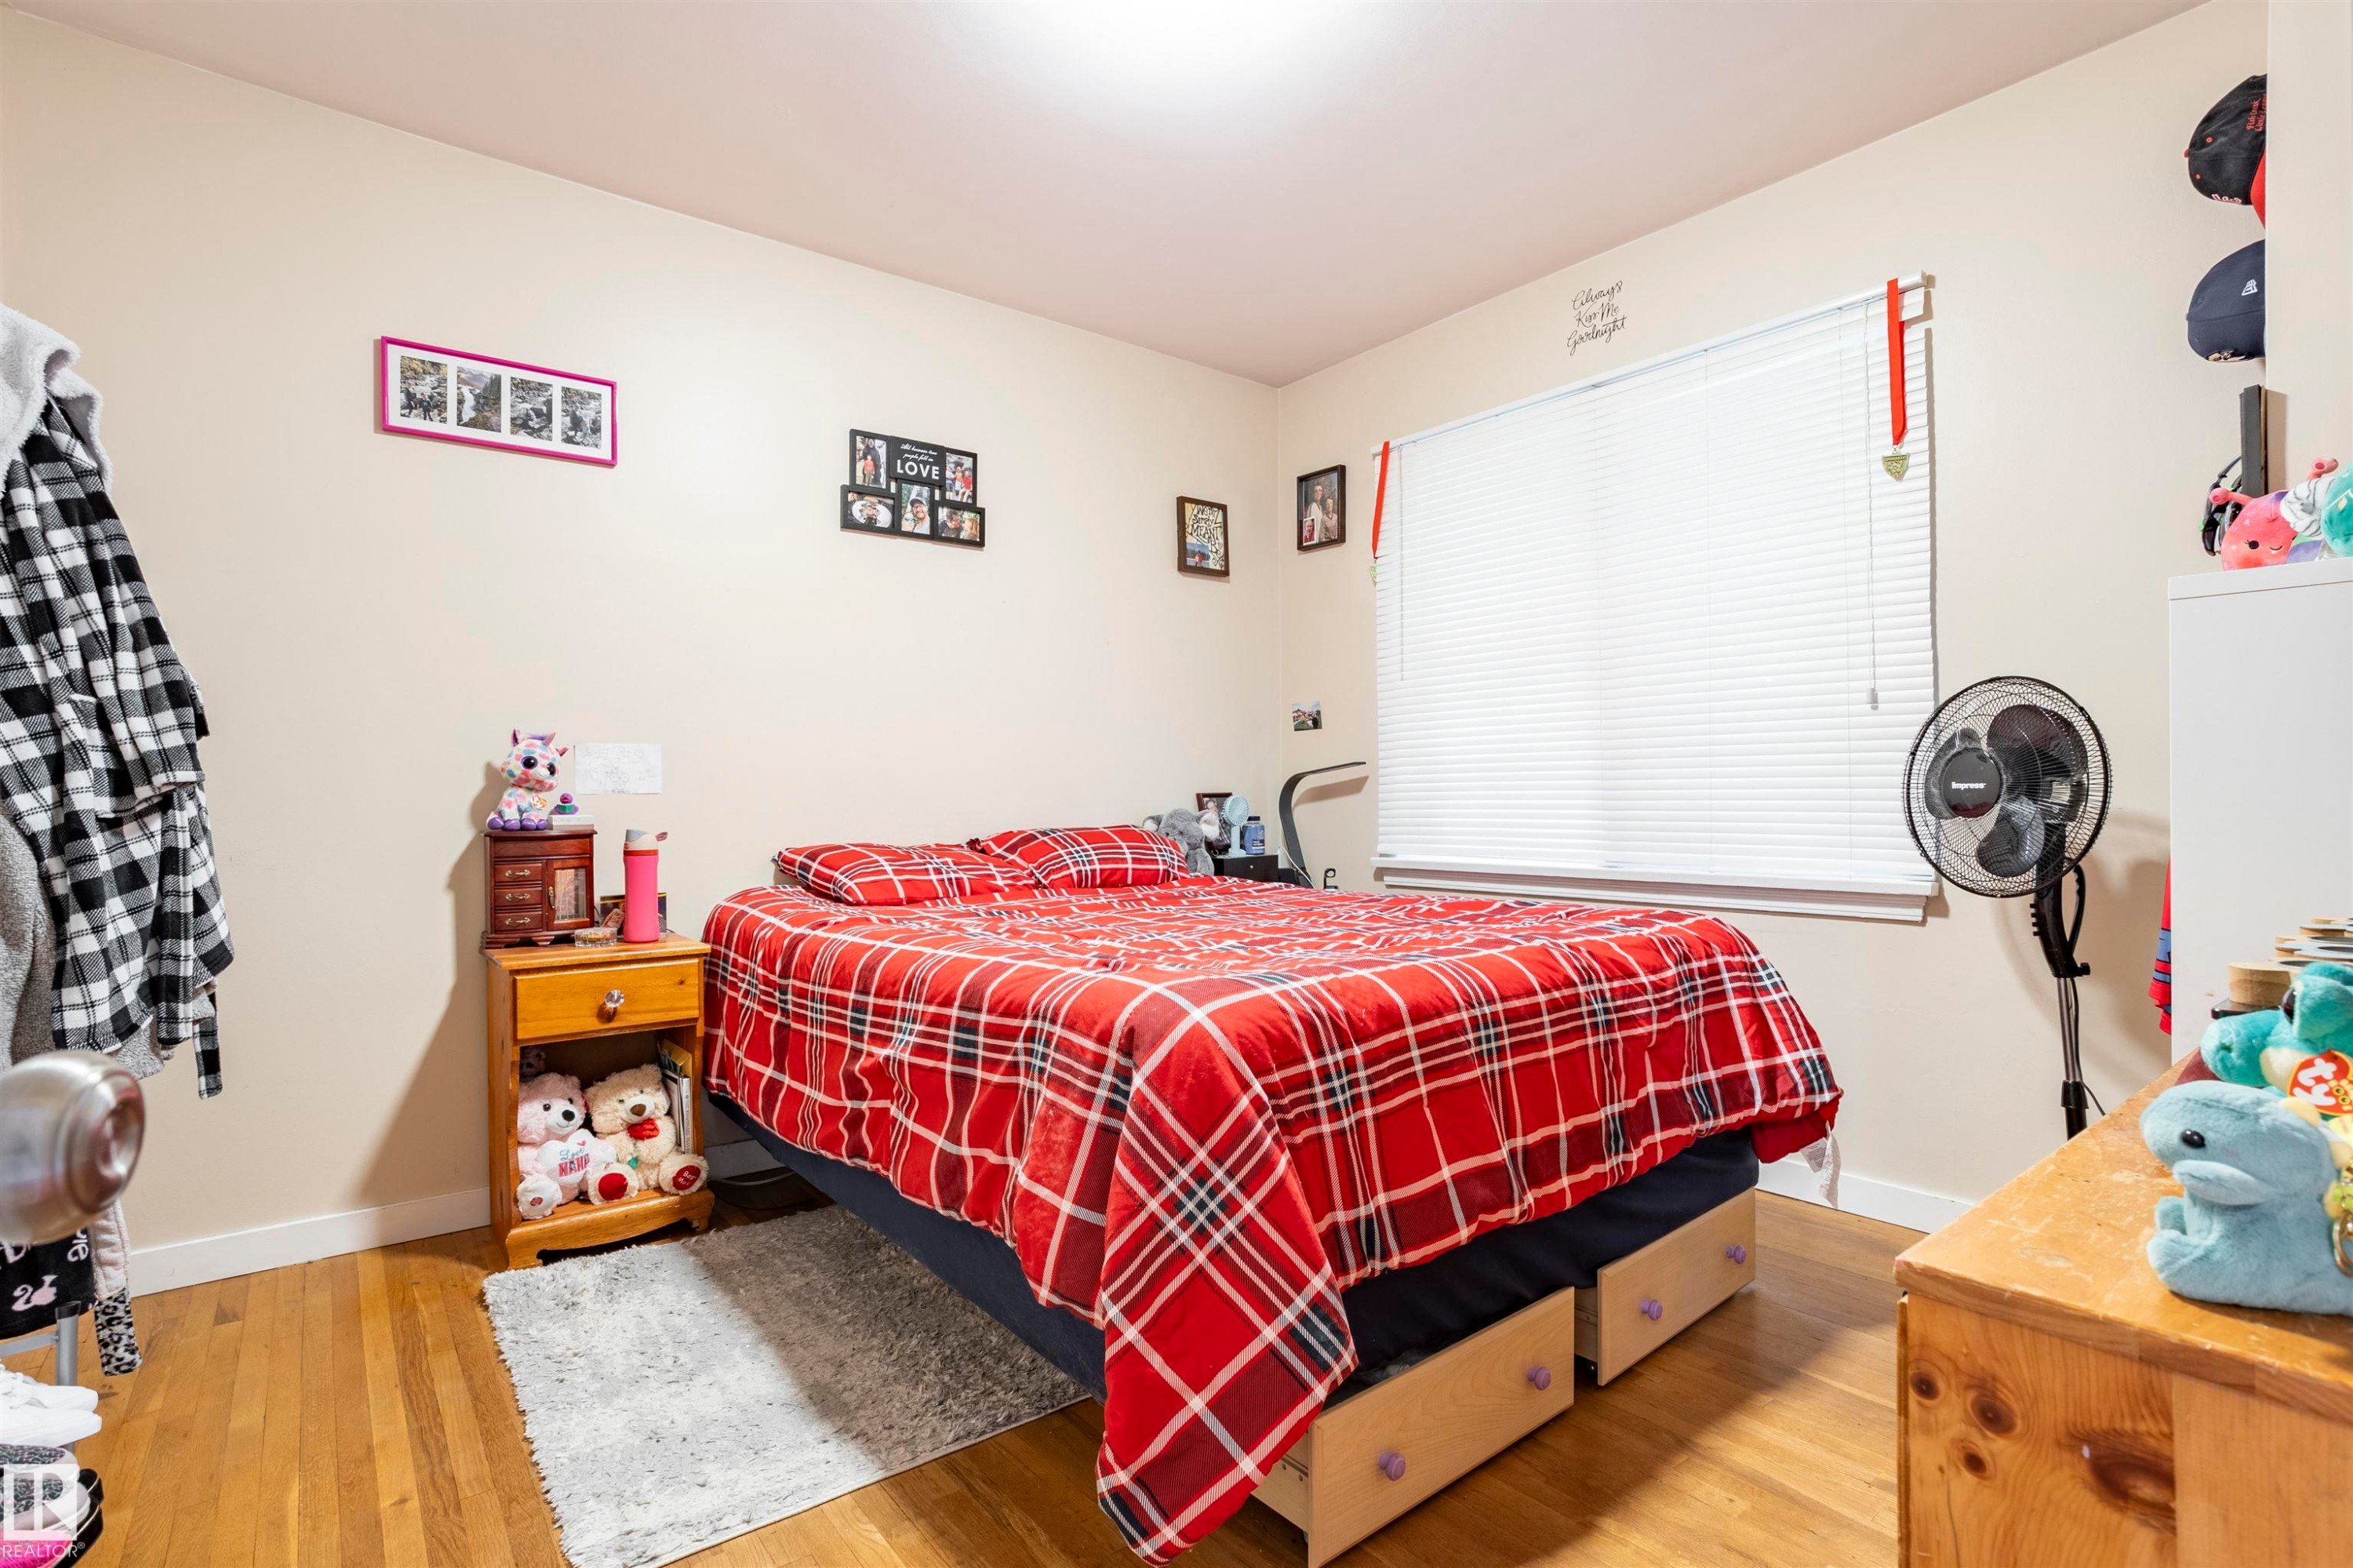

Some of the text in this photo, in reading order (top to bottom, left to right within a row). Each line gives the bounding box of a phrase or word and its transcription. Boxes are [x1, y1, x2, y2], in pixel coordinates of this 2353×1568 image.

[1571, 280, 1623, 311] Always
[1573, 301, 1620, 328] Kiss Me
[1566, 315, 1627, 356] Goodnight
[896, 459, 940, 480] LOVE
[2293, 1057, 2337, 1107] ty
[559, 1147, 586, 1162] Love
